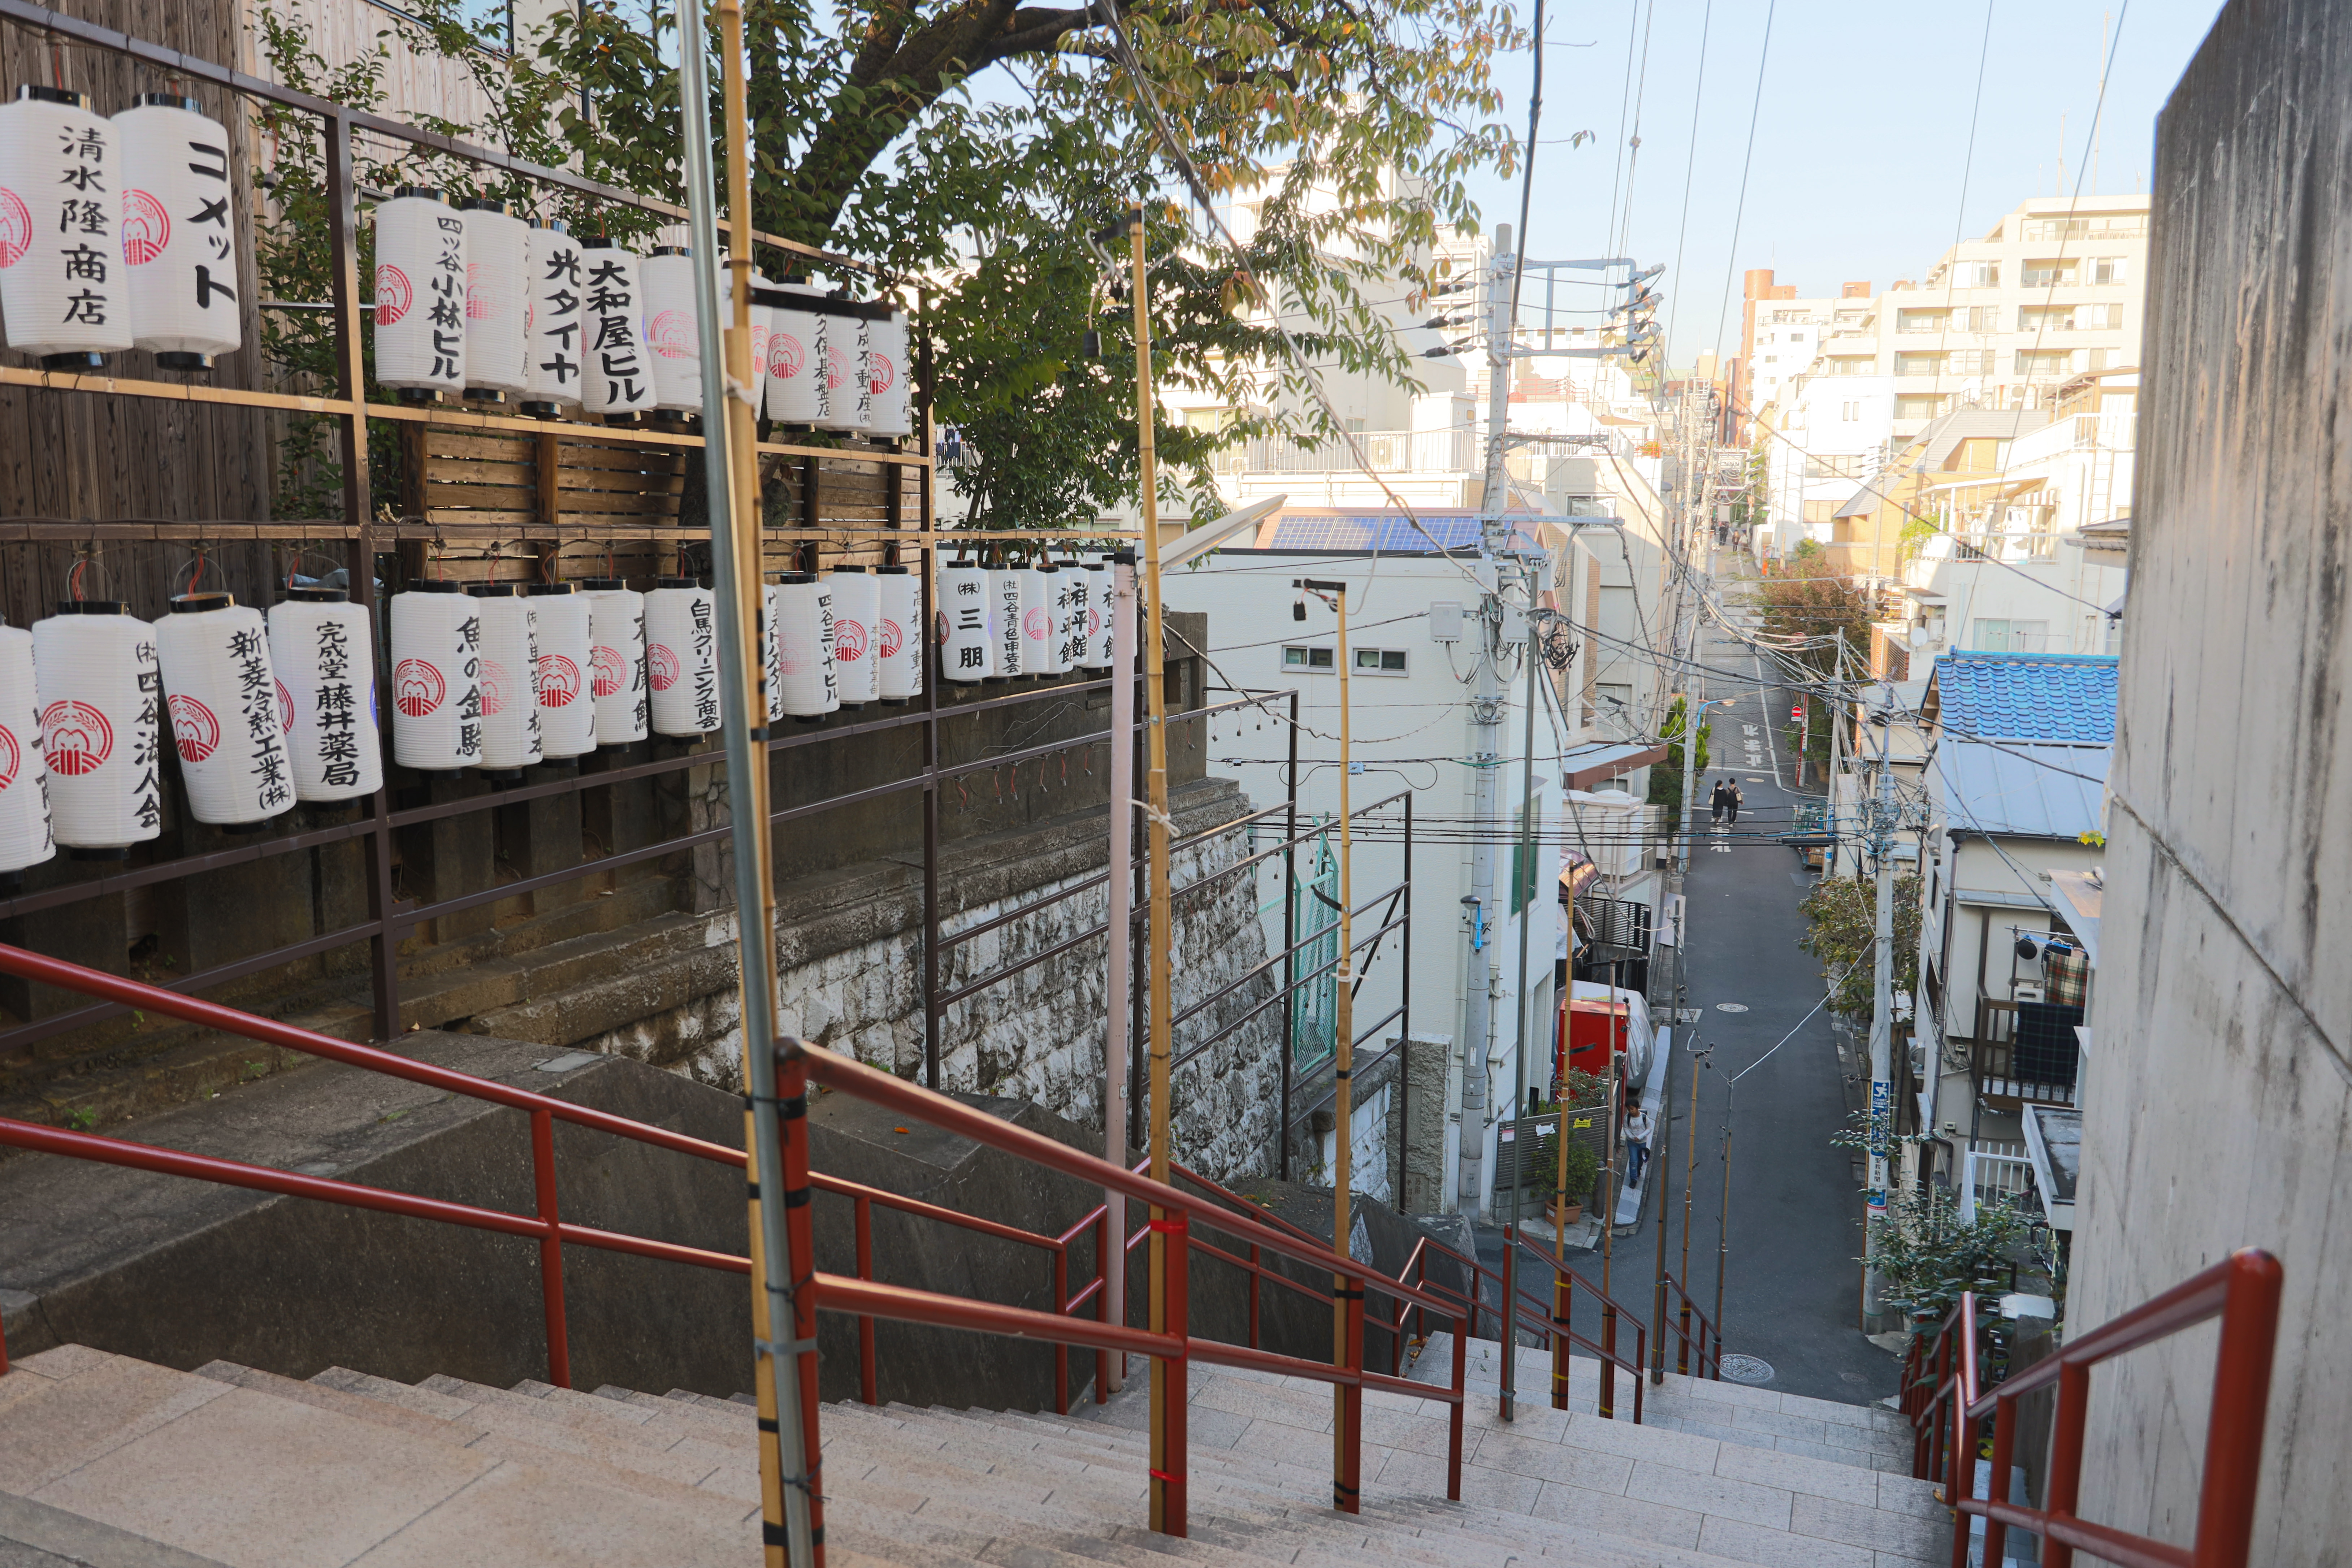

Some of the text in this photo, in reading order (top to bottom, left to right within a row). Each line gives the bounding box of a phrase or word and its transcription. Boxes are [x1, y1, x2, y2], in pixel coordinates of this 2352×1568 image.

[58, 126, 109, 325] 清水隆商店
[186, 141, 236, 309] コメット
[426, 217, 464, 380] 四ツ谷小林ビル
[540, 248, 581, 384] 光タイヤ
[587, 260, 645, 404] 大和屋ビル
[691, 598, 719, 728] 白馬クリーニング商会
[958, 582, 983, 668] (株)三朋
[1002, 580, 1019, 673] (社)四谷青色申告会
[1057, 587, 1073, 664] 祥平館
[1071, 582, 1088, 658] 祥平館
[226, 628, 291, 809] 新菱冷熱工業(株)
[316, 621, 360, 786] 完成堂藤井薬局
